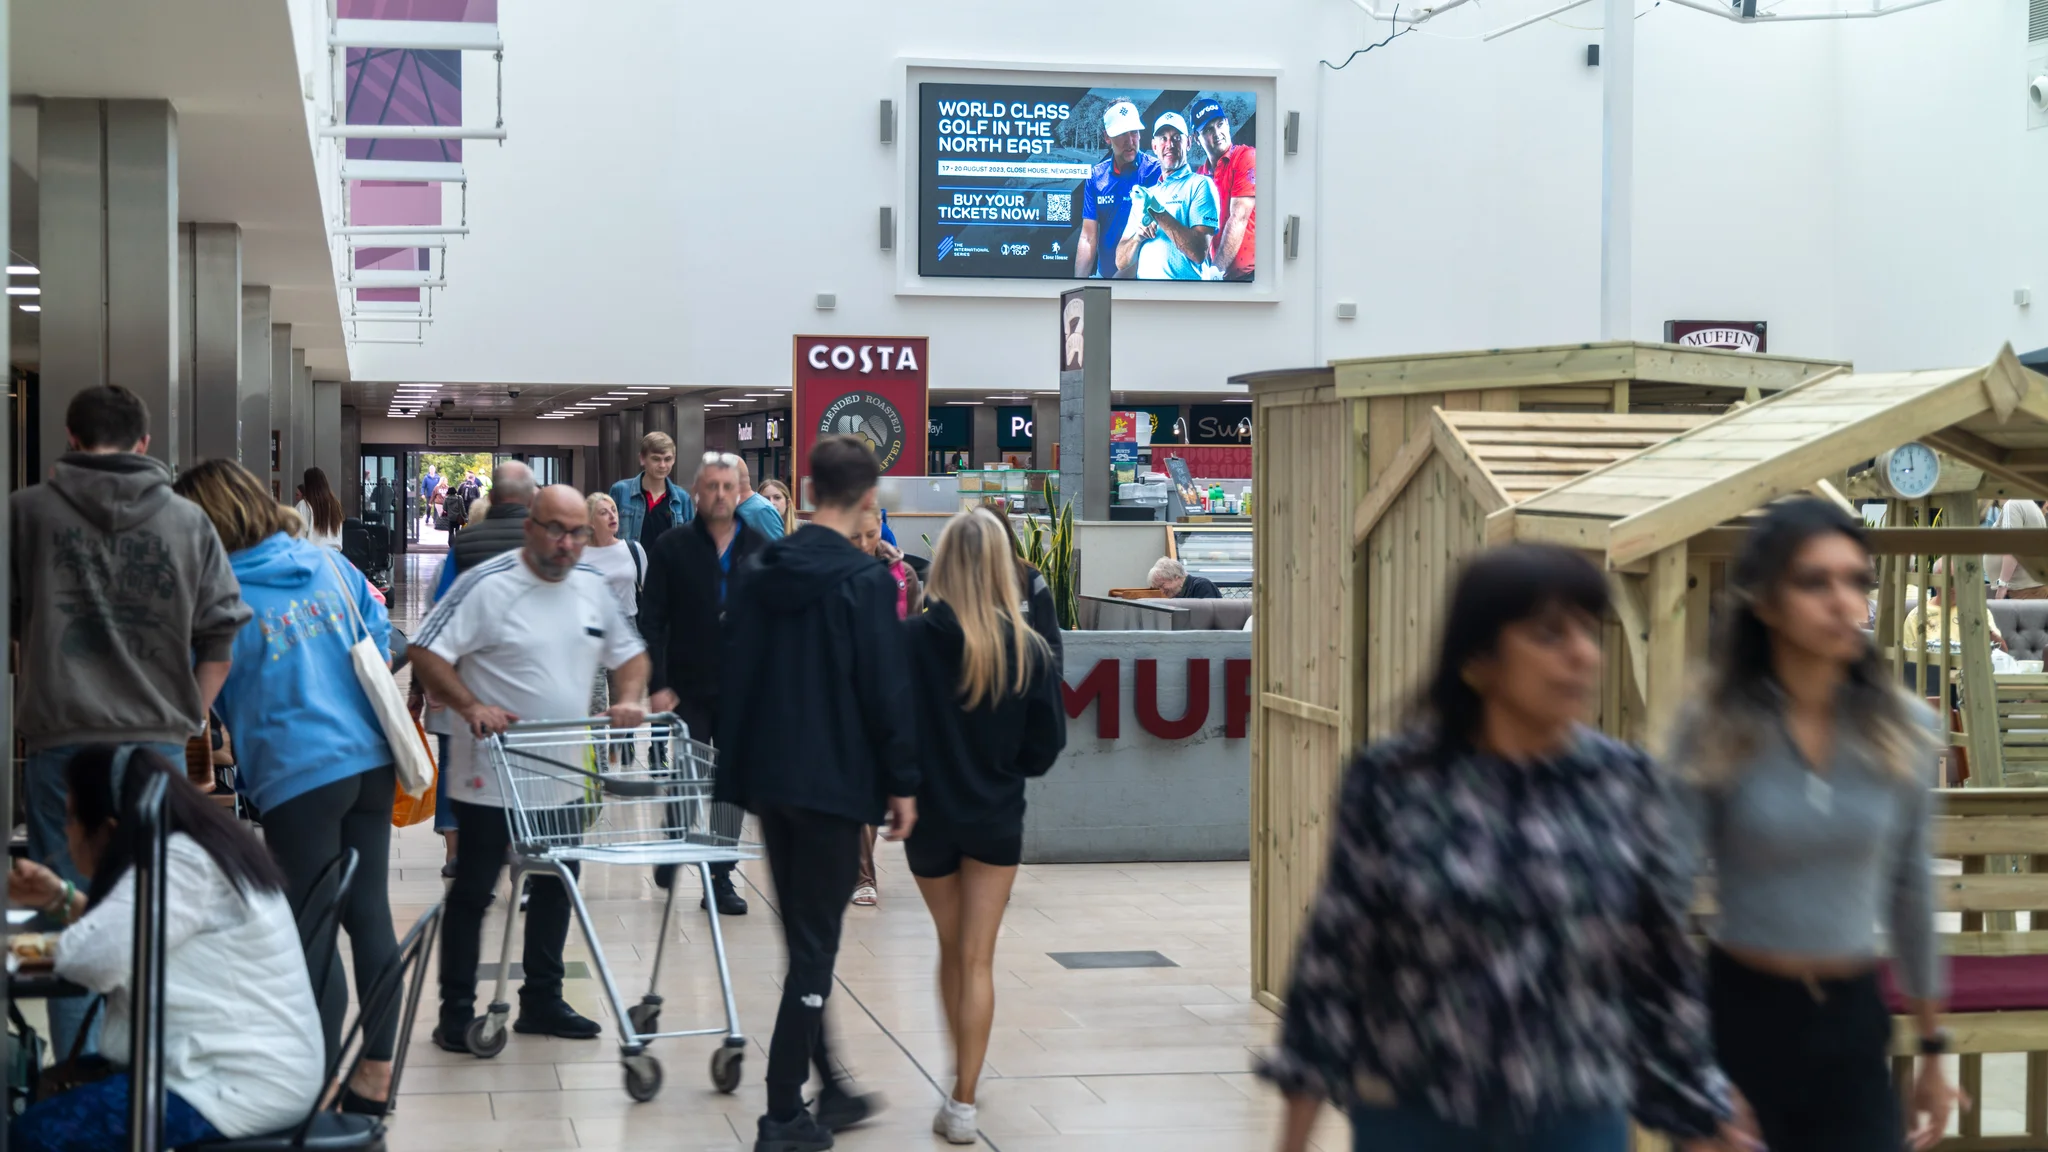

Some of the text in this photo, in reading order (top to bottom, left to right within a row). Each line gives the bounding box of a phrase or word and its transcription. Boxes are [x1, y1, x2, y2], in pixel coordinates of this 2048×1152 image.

[938, 101, 1070, 120] WORLD CLASS
[938, 119, 1051, 136] GOLF IN THE
[938, 137, 1054, 154] NORTH EAST
[954, 194, 1024, 207] BUY YOUR
[938, 207, 1040, 220] TICKETS NOW!
[1688, 330, 1754, 346] MUFFIN
[808, 344, 919, 374] COSTA
[821, 394, 860, 432] BLENDED
[865, 395, 901, 433] ROASTED
